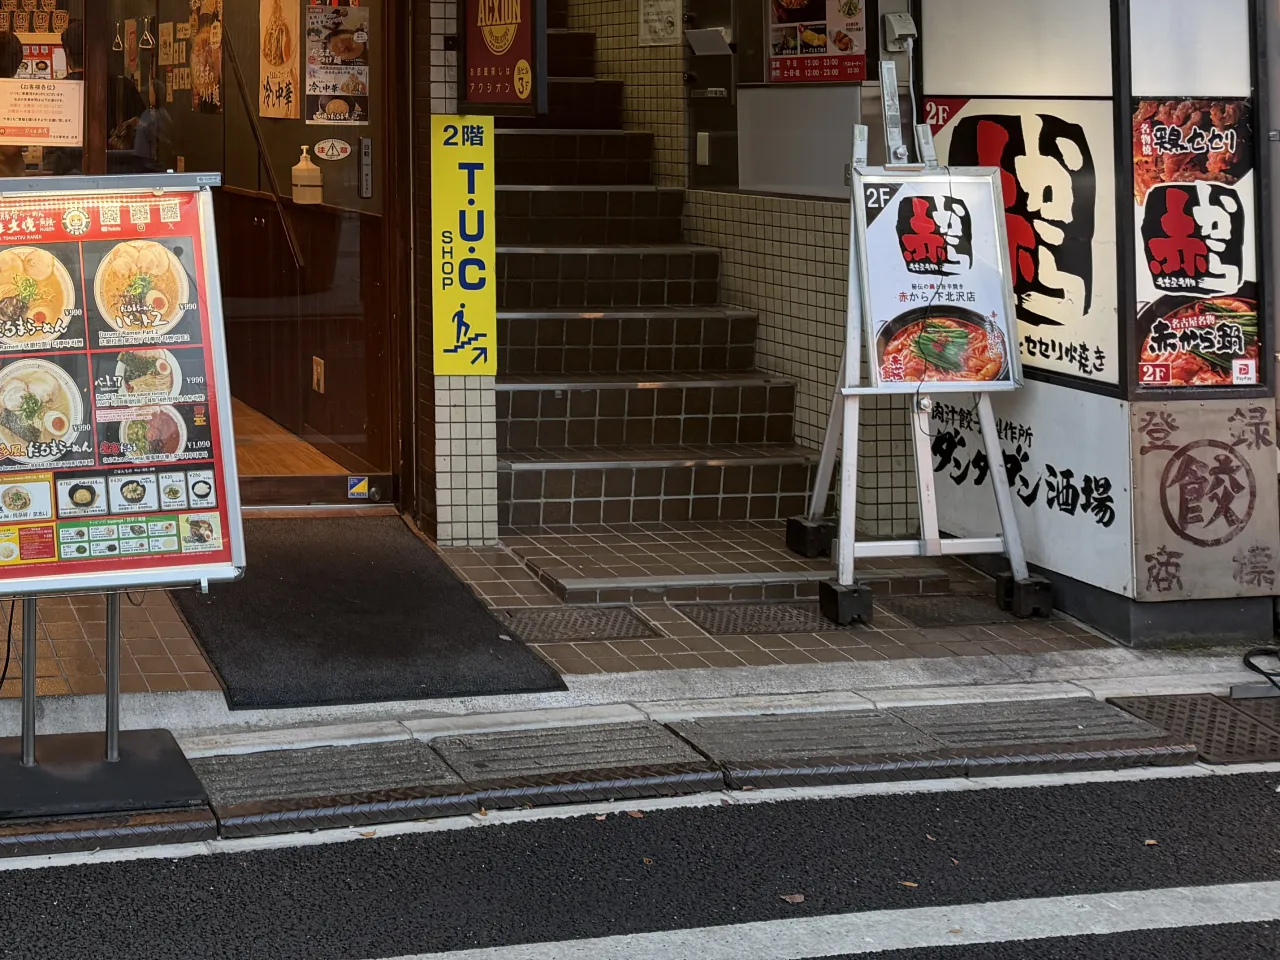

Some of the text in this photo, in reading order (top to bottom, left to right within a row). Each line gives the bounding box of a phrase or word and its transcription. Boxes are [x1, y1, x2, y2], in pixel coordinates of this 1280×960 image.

[469, 82, 511, 93] アクシオン
[517, 76, 530, 95] 3F
[925, 100, 950, 127] 2F
[442, 123, 485, 147] 2階
[866, 186, 891, 209] 2F
[1147, 180, 1240, 293] 赤から
[440, 230, 454, 291] SHOP
[898, 291, 976, 303] 赤から 下北沢店
[114, 311, 169, 329] パート2
[1171, 314, 1216, 329] 名古屋名物
[1147, 318, 1245, 355] 赤から鍋
[1019, 335, 1106, 376] セセリ焼き
[1142, 365, 1167, 381] 2F
[1137, 405, 1274, 456] 登 録
[1166, 453, 1246, 531] 餃
[1146, 545, 1184, 593] 商
